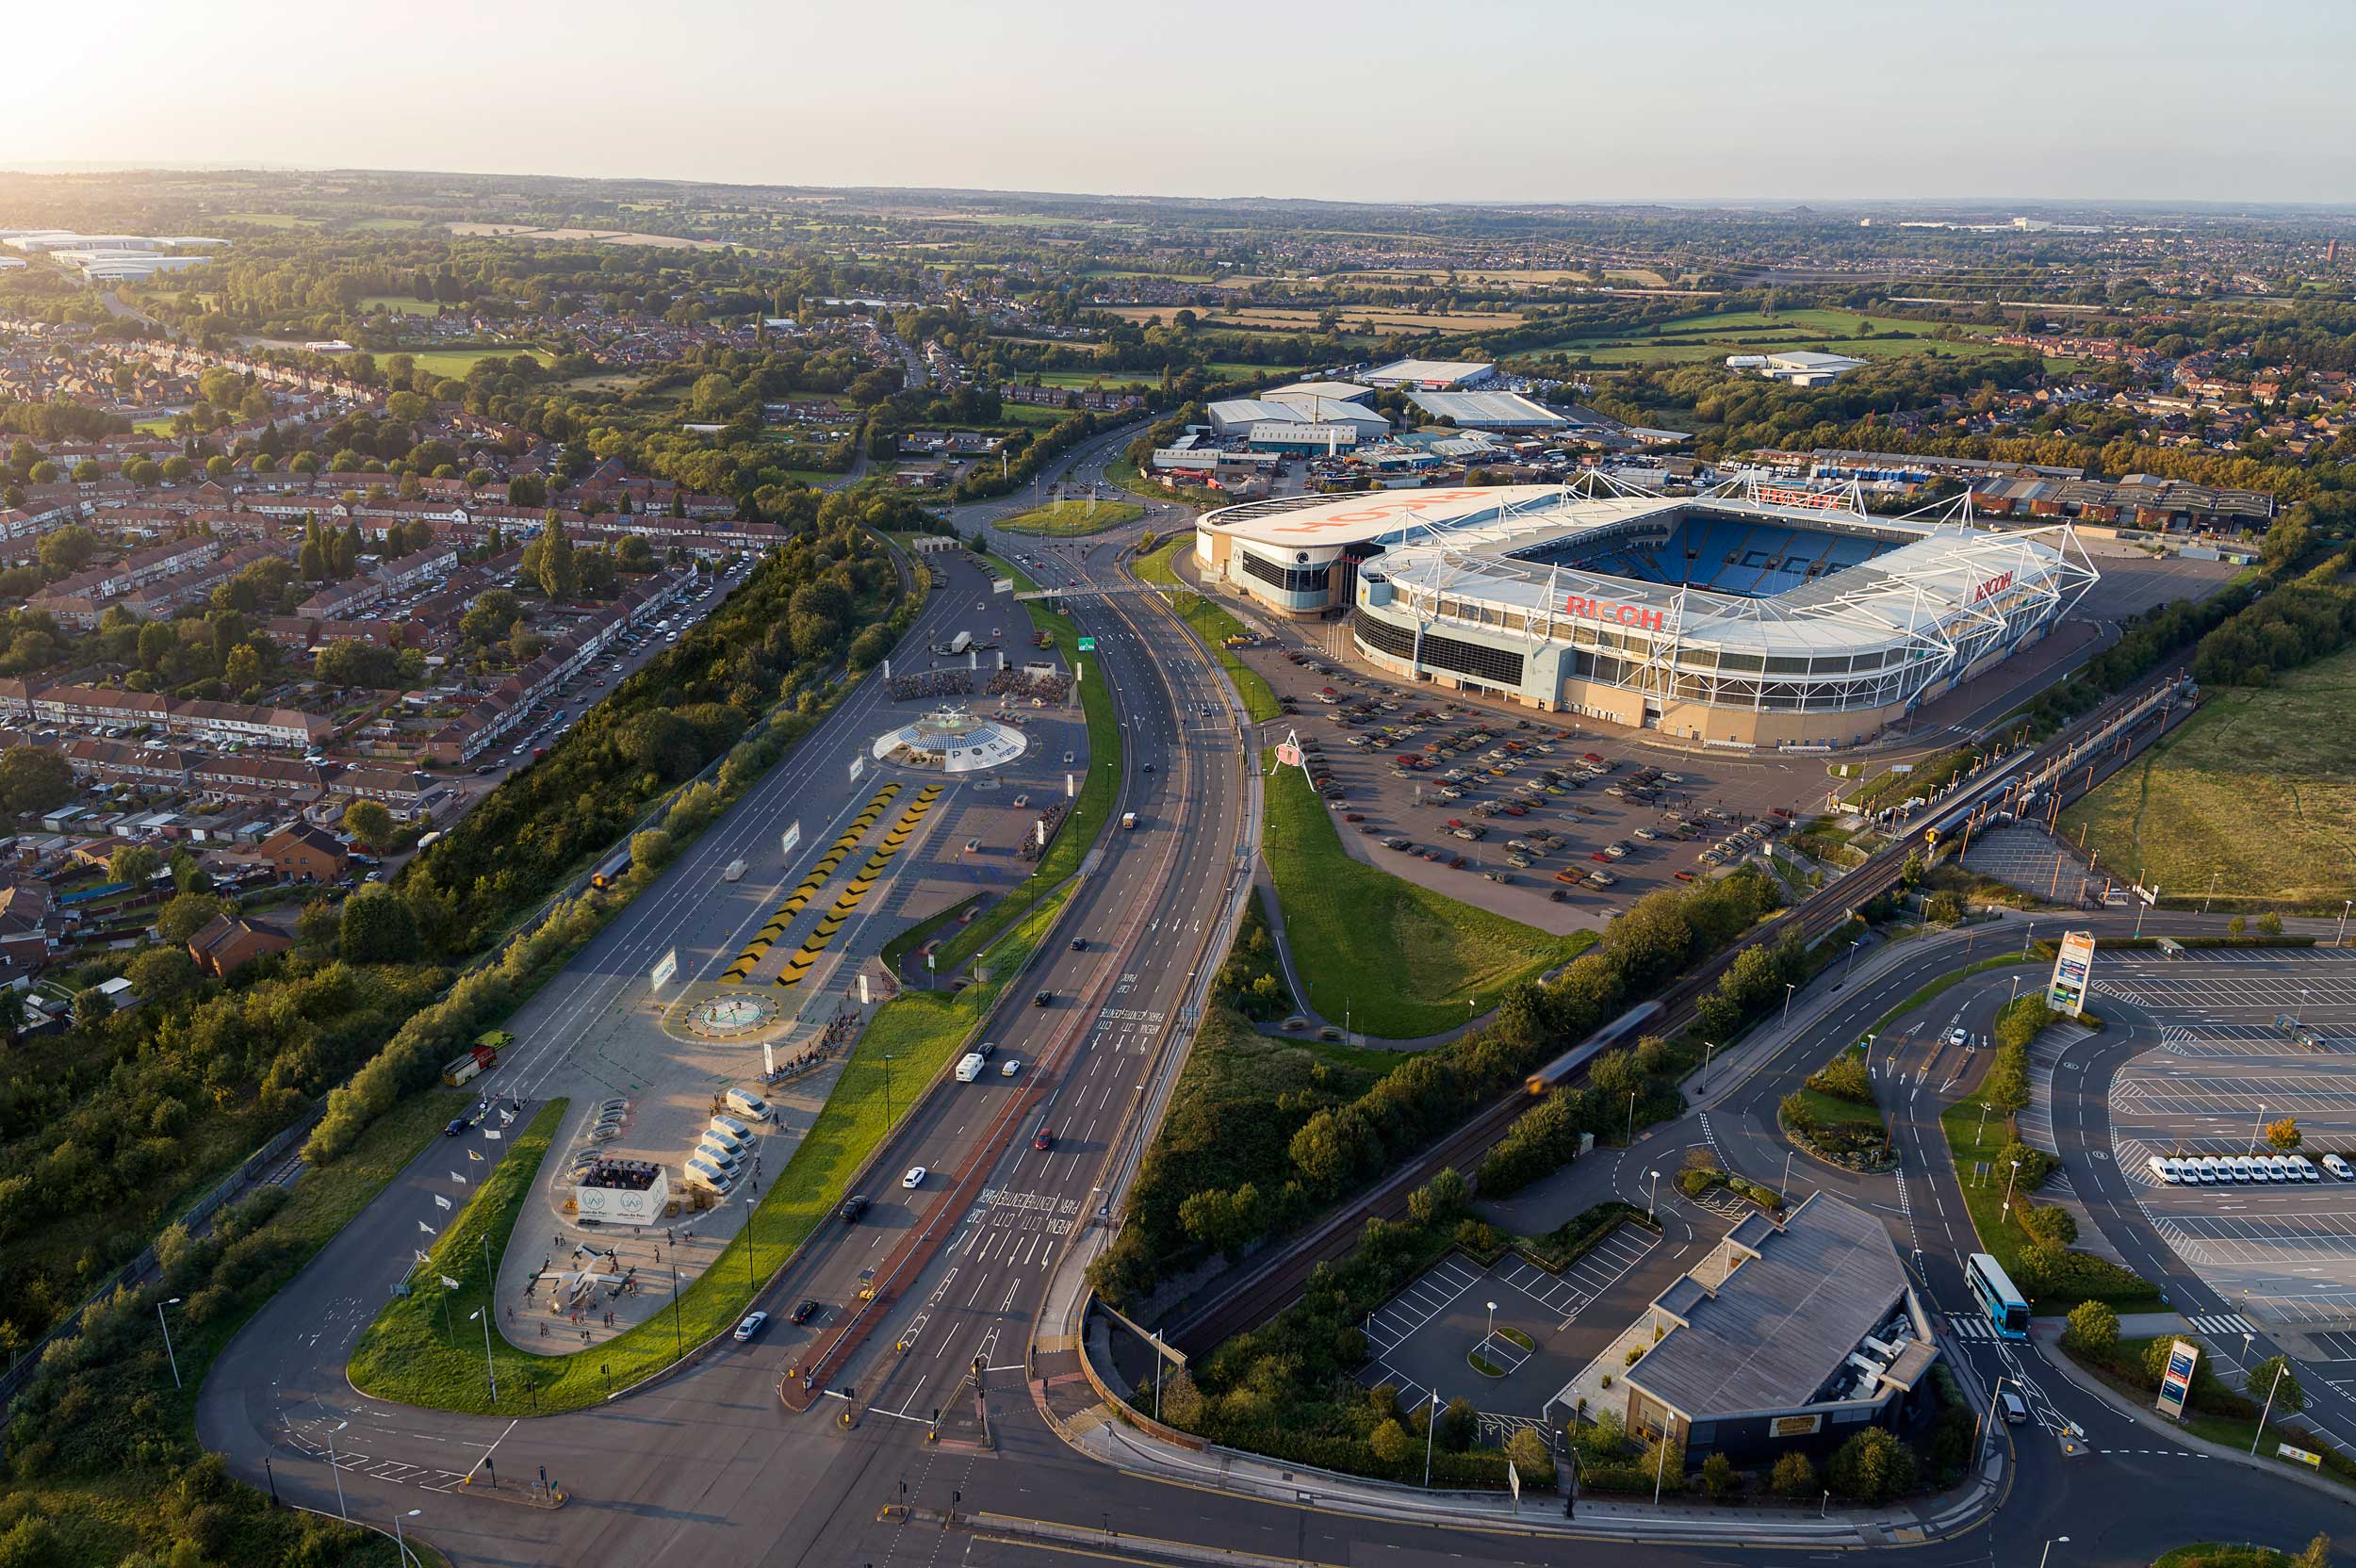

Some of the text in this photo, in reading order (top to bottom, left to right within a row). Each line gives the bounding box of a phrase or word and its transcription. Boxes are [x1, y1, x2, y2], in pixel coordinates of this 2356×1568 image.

[1272, 491, 1493, 533] RICOH
[1974, 569, 2013, 604] RICOH
[1566, 595, 1663, 631] RICOH
[1601, 645, 1624, 654] SOUTH
[1121, 973, 1138, 983] PARK
[1117, 985, 1131, 994] CAR
[1146, 1011, 1165, 1022] PARK
[1098, 1021, 1113, 1030] CITY
[1121, 1022, 1136, 1033] CITY
[1139, 1023, 1161, 1035] ARENA
[584, 1197, 603, 1207] UAP
[622, 1199, 641, 1208] UAP
[977, 1188, 1000, 1204] PARK
[998, 1190, 1028, 1208] CENTRE
[1026, 1194, 1055, 1212] CENTRE
[1057, 1199, 1081, 1215] PARK
[967, 1208, 986, 1224] CAR
[990, 1212, 1015, 1228] CITY
[1019, 1215, 1042, 1231] CITY
[1045, 1217, 1074, 1235] ARENA
